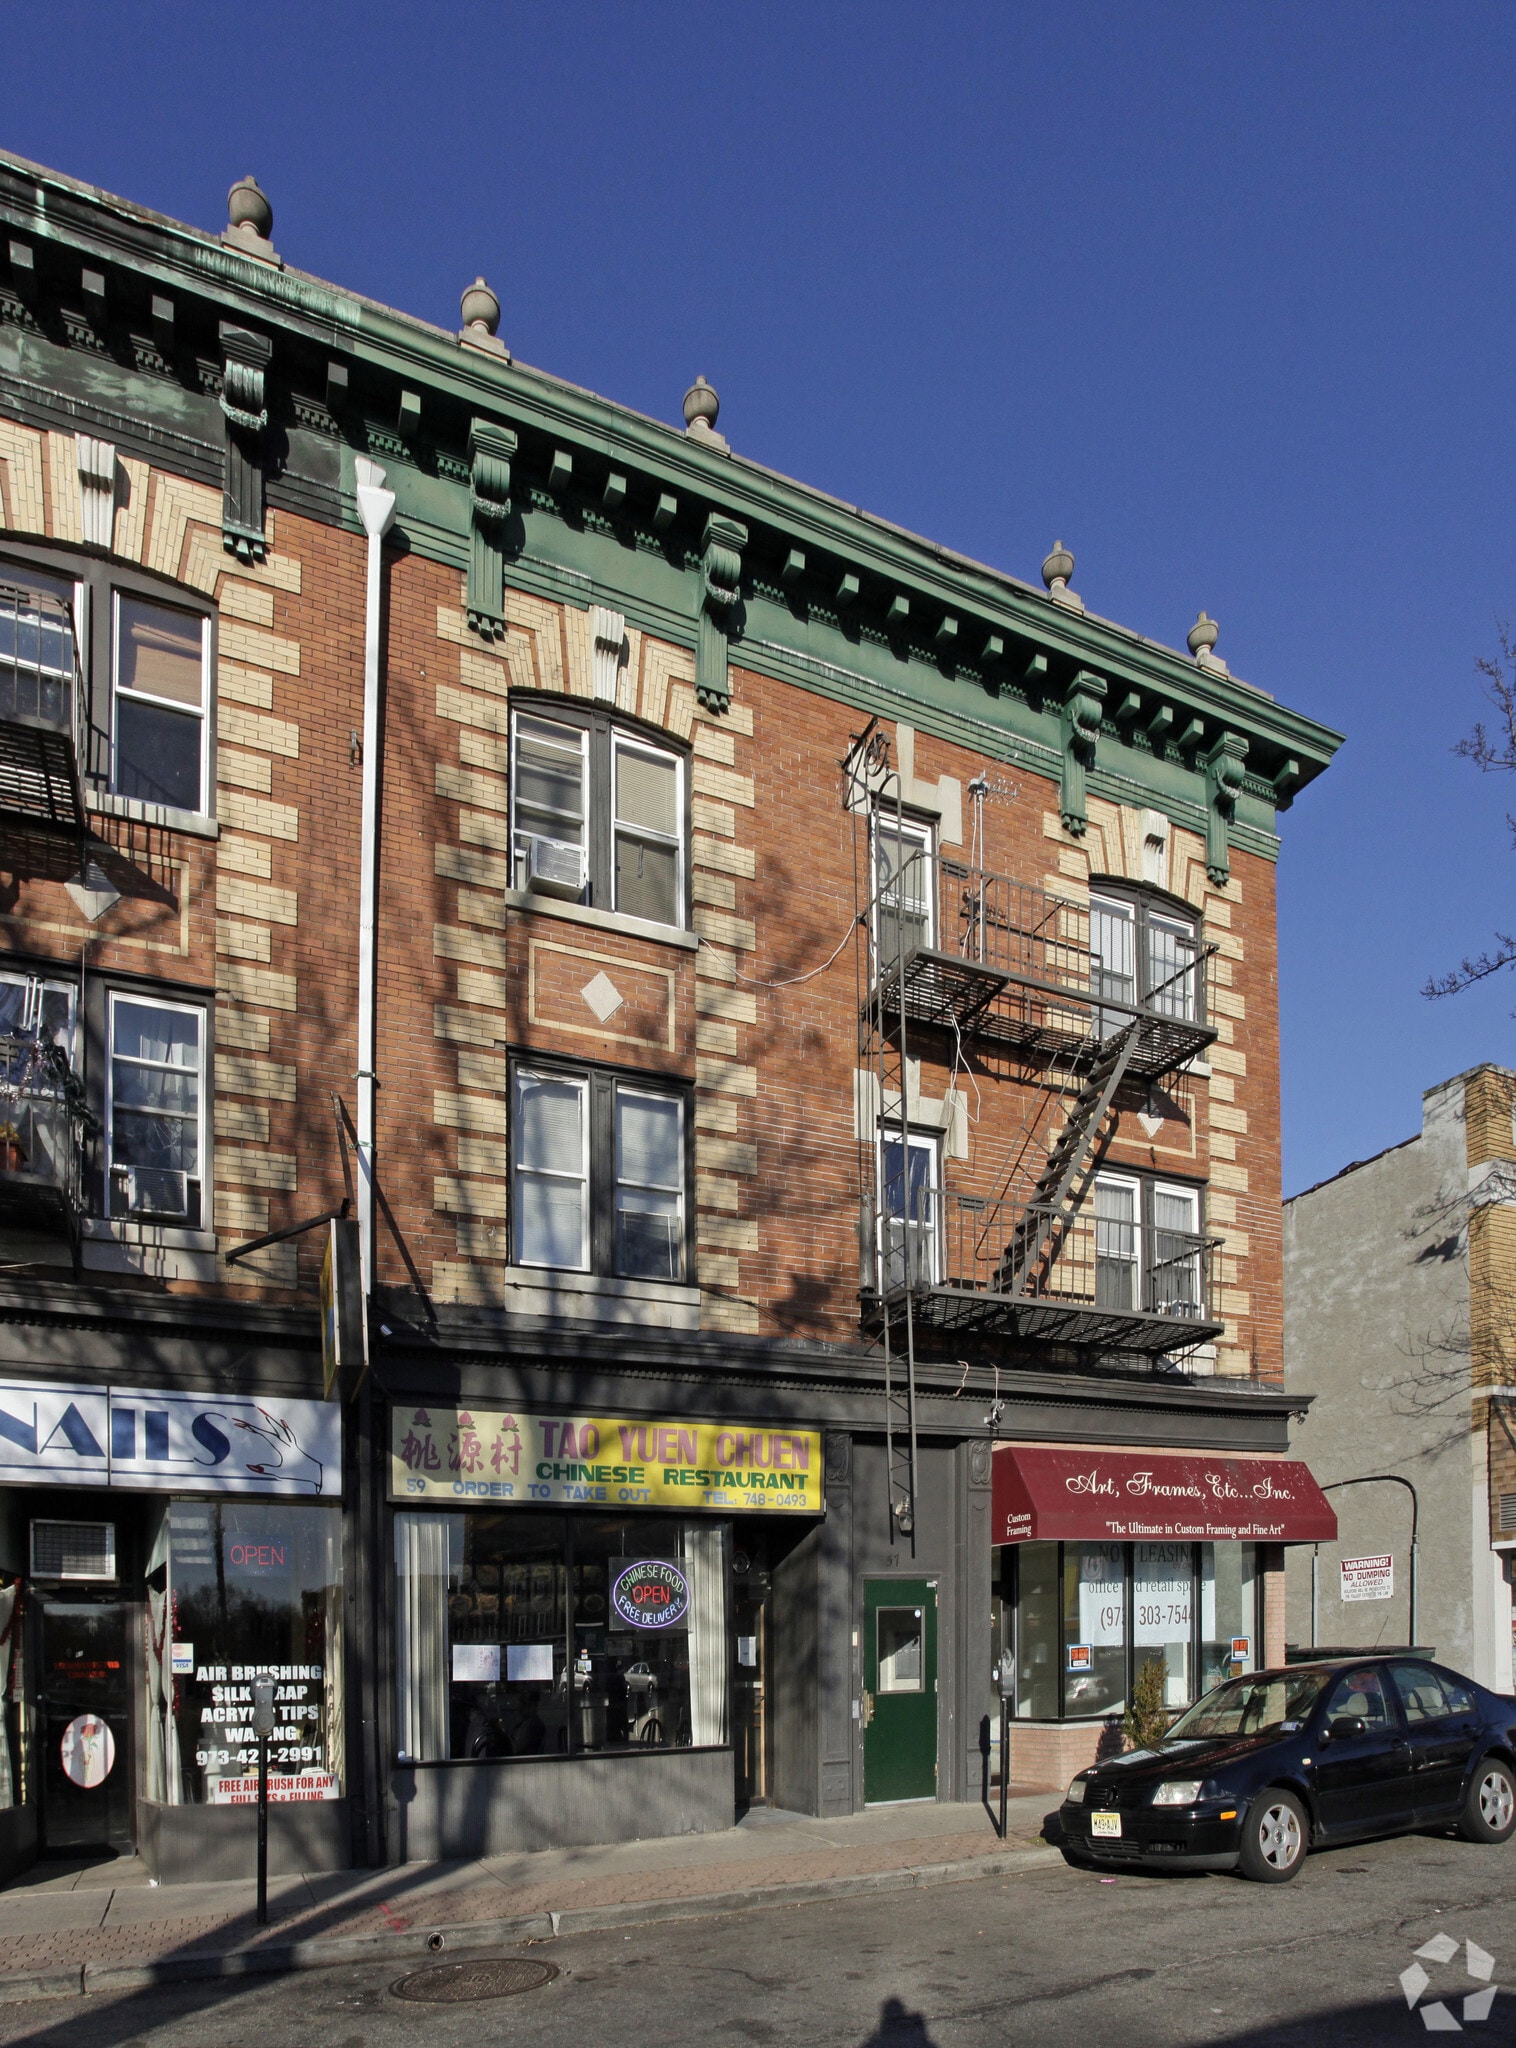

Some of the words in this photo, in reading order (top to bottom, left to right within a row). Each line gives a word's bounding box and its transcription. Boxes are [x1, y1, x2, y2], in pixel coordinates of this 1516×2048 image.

[0, 1402, 230, 1466] NAILS
[400, 1428, 524, 1476] 桃源村
[538, 1420, 600, 1461] TAO
[618, 1425, 698, 1465] YUEN
[716, 1432, 810, 1470] CHUEN
[535, 1463, 645, 1484] CHINESE
[663, 1468, 809, 1490] RESTAURANT
[1065, 1469, 1119, 1498] Art,
[406, 1478, 427, 1494] 59
[453, 1481, 514, 1497] ORDER
[528, 1484, 550, 1499] TO
[562, 1485, 607, 1501] TAKE
[618, 1488, 651, 1502] OUT
[743, 1492, 807, 1507] 748-0493
[1007, 1512, 1031, 1524] Custom
[1006, 1524, 1032, 1537] Framing
[1128, 1521, 1163, 1534] Ultimate
[1165, 1523, 1172, 1534] in
[1174, 1522, 1205, 1535] Custom
[1206, 1523, 1237, 1539] Framing
[1238, 1523, 1251, 1535] and
[1253, 1523, 1268, 1535] Fine
[230, 1545, 284, 1566] OPEN
[1140, 1544, 1194, 1563] LEASIN
[1344, 1557, 1389, 1571] WARNING!
[620, 1564, 659, 1591] CHINESE
[660, 1567, 684, 1593] FOOD
[1343, 1572, 1354, 1581] NO
[1357, 1569, 1391, 1580] DUMPING
[1350, 1578, 1383, 1588] ALLOWED
[1088, 1577, 1119, 1593] office
[1146, 1577, 1174, 1593] retail
[632, 1585, 671, 1604] OPEN
[618, 1595, 640, 1622] FREE
[196, 1666, 227, 1681] AIR
[212, 1686, 252, 1702] SILK
[279, 1705, 319, 1721] TIPS
[225, 1726, 297, 1743] WANG
[196, 1746, 322, 1766] 973-42-2991
[219, 1780, 241, 1793] FREE
[296, 1777, 314, 1789] FOR
[316, 1776, 335, 1788] ANY
